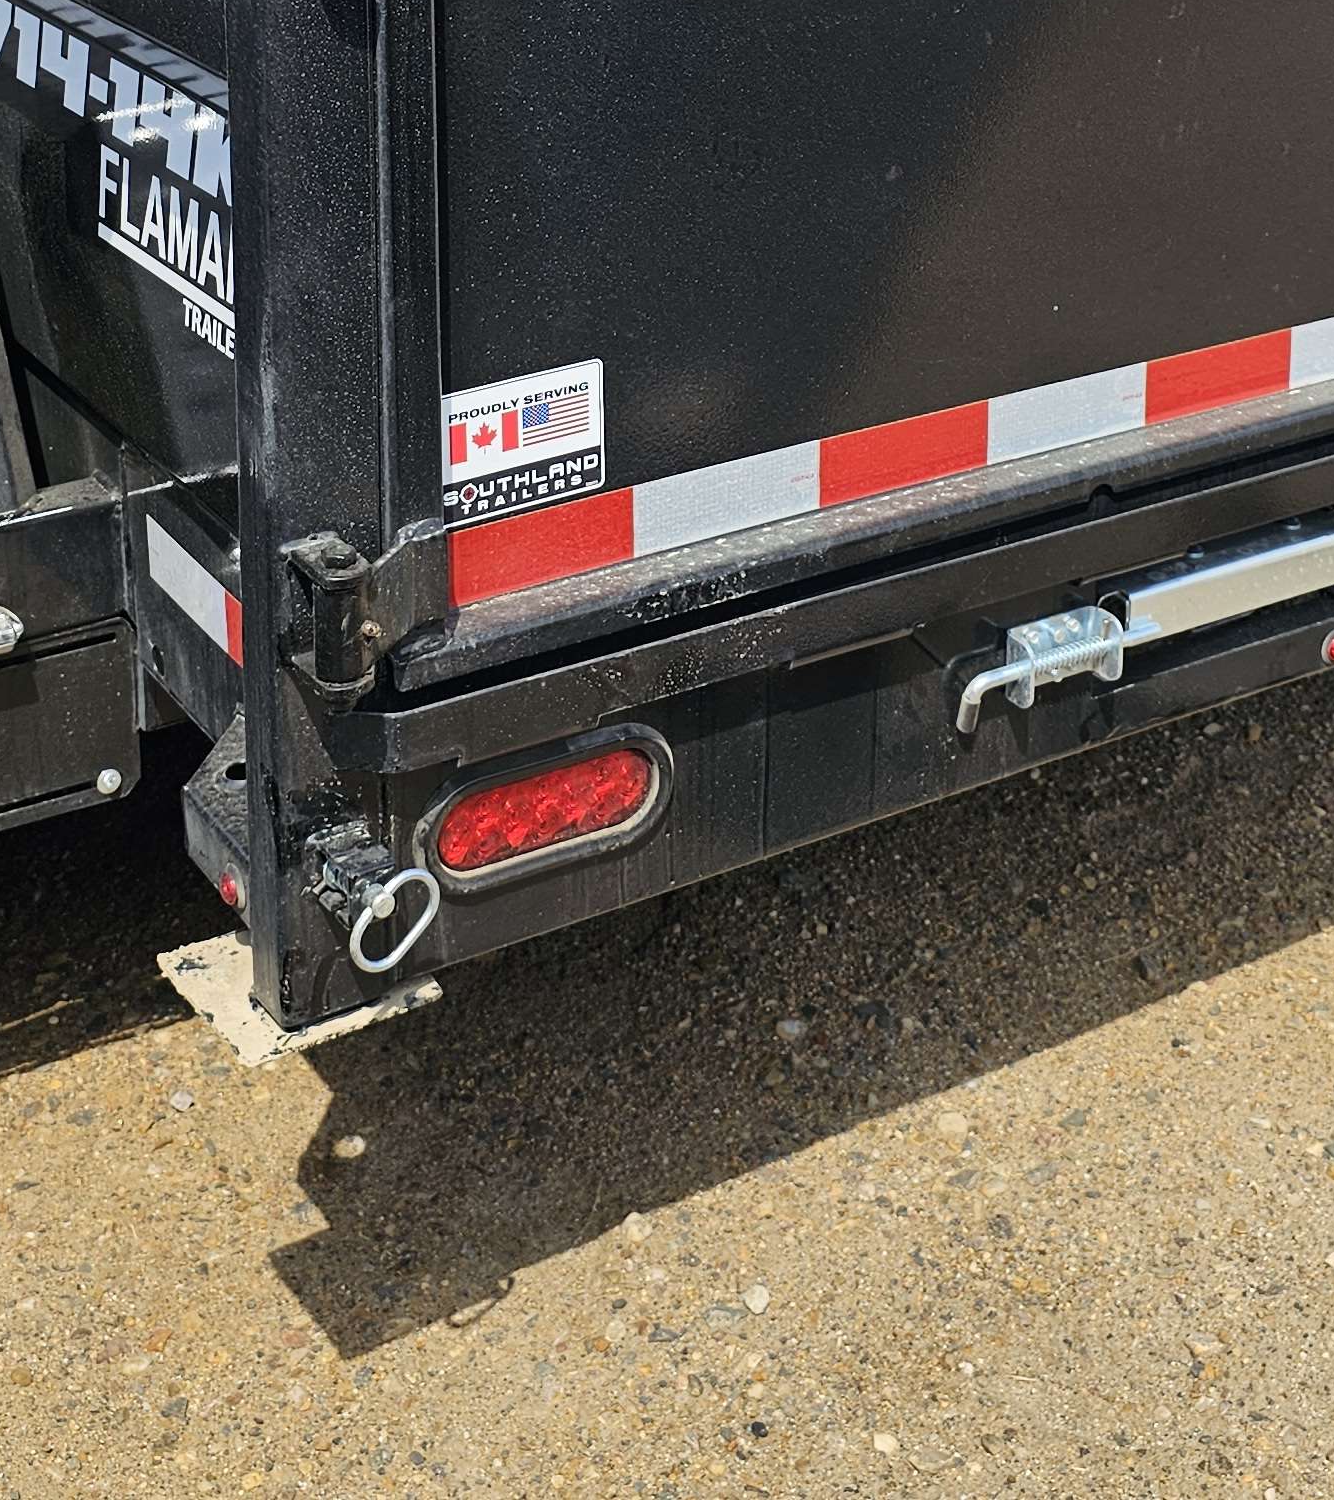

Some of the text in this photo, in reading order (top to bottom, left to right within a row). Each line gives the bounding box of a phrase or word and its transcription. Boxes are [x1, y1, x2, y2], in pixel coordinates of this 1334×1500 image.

[182, 297, 236, 360] TRAILE
[448, 382, 589, 424] PROUDLY SERVING
[443, 453, 599, 507] SOUTHLAND
[461, 474, 583, 515] TRAILERS
